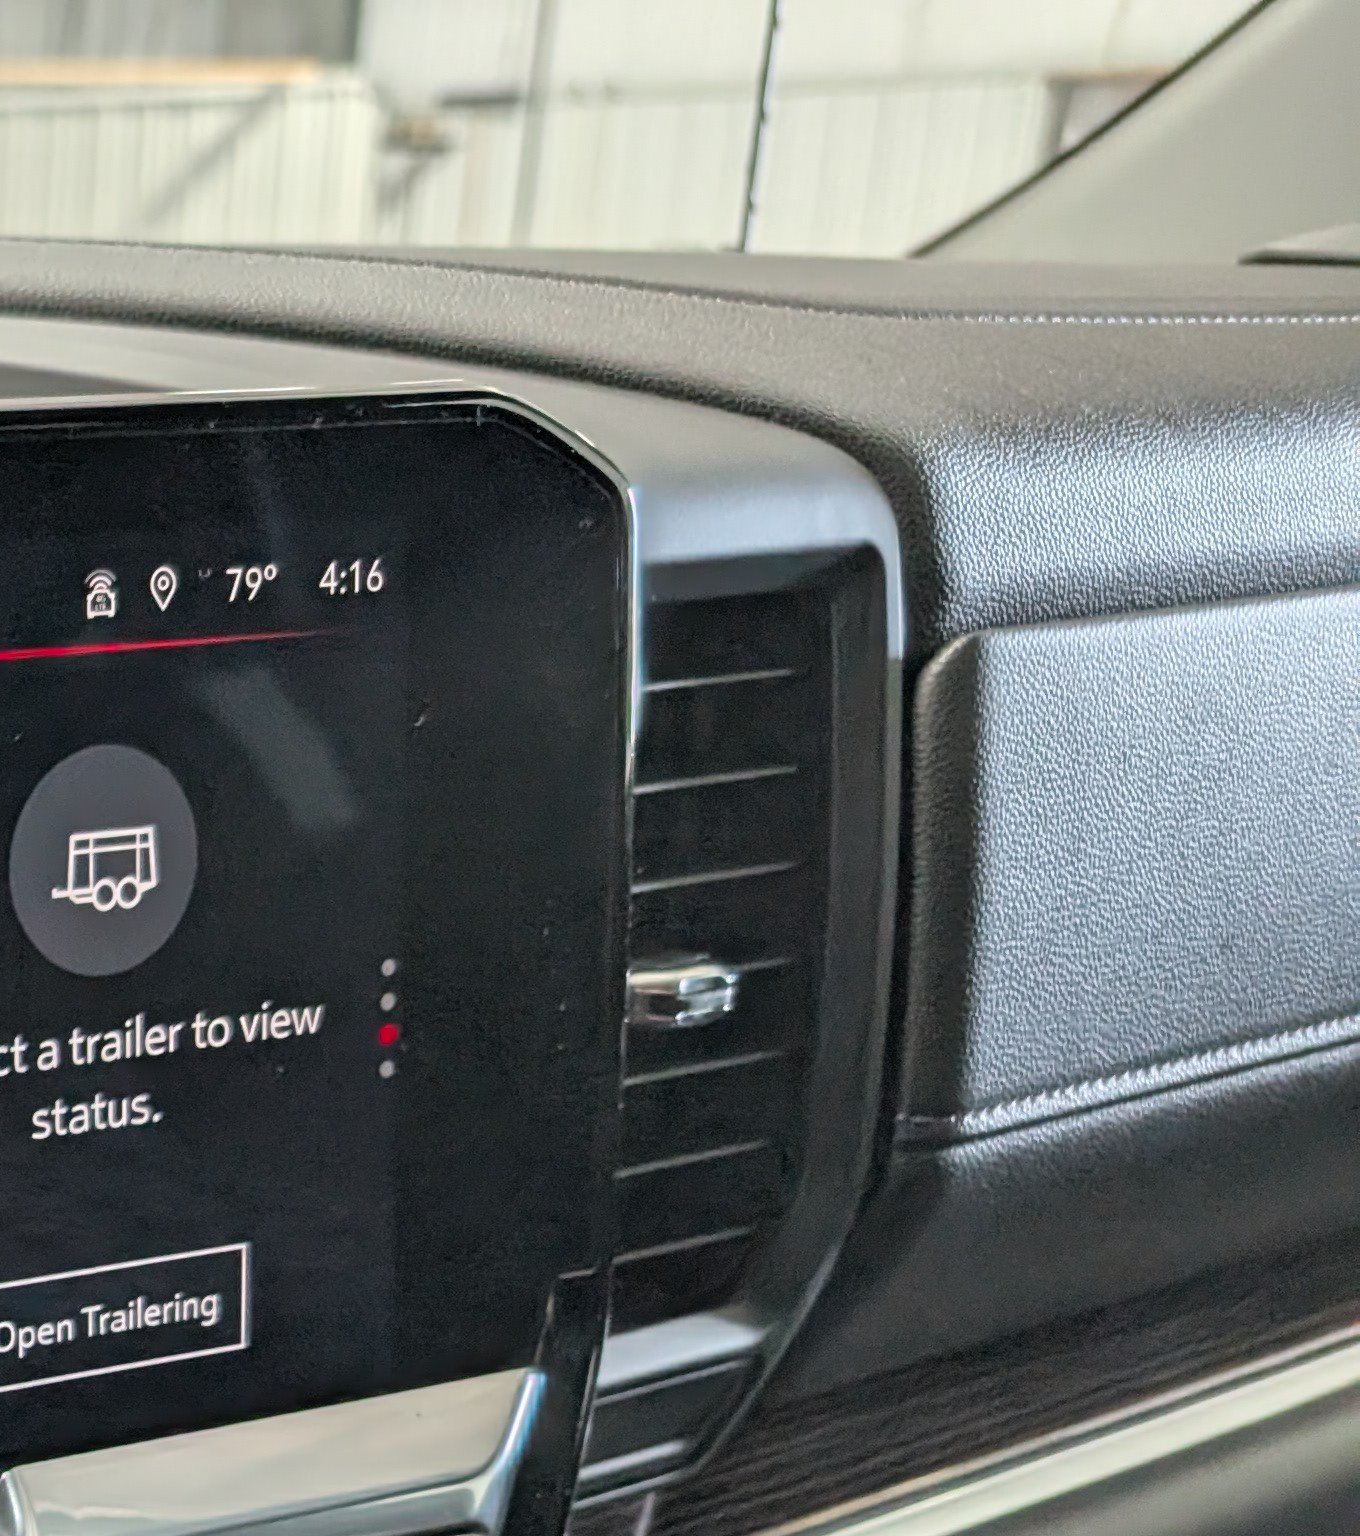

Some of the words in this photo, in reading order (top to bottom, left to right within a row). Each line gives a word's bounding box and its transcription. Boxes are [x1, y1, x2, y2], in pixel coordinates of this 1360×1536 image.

[318, 559, 385, 595] 4:16
[37, 1040, 60, 1071] a
[69, 1013, 183, 1065] trailer
[191, 1011, 232, 1049] to
[239, 1001, 326, 1043] view
[31, 1092, 164, 1141] status.
[80, 1293, 221, 1338] Trailering
